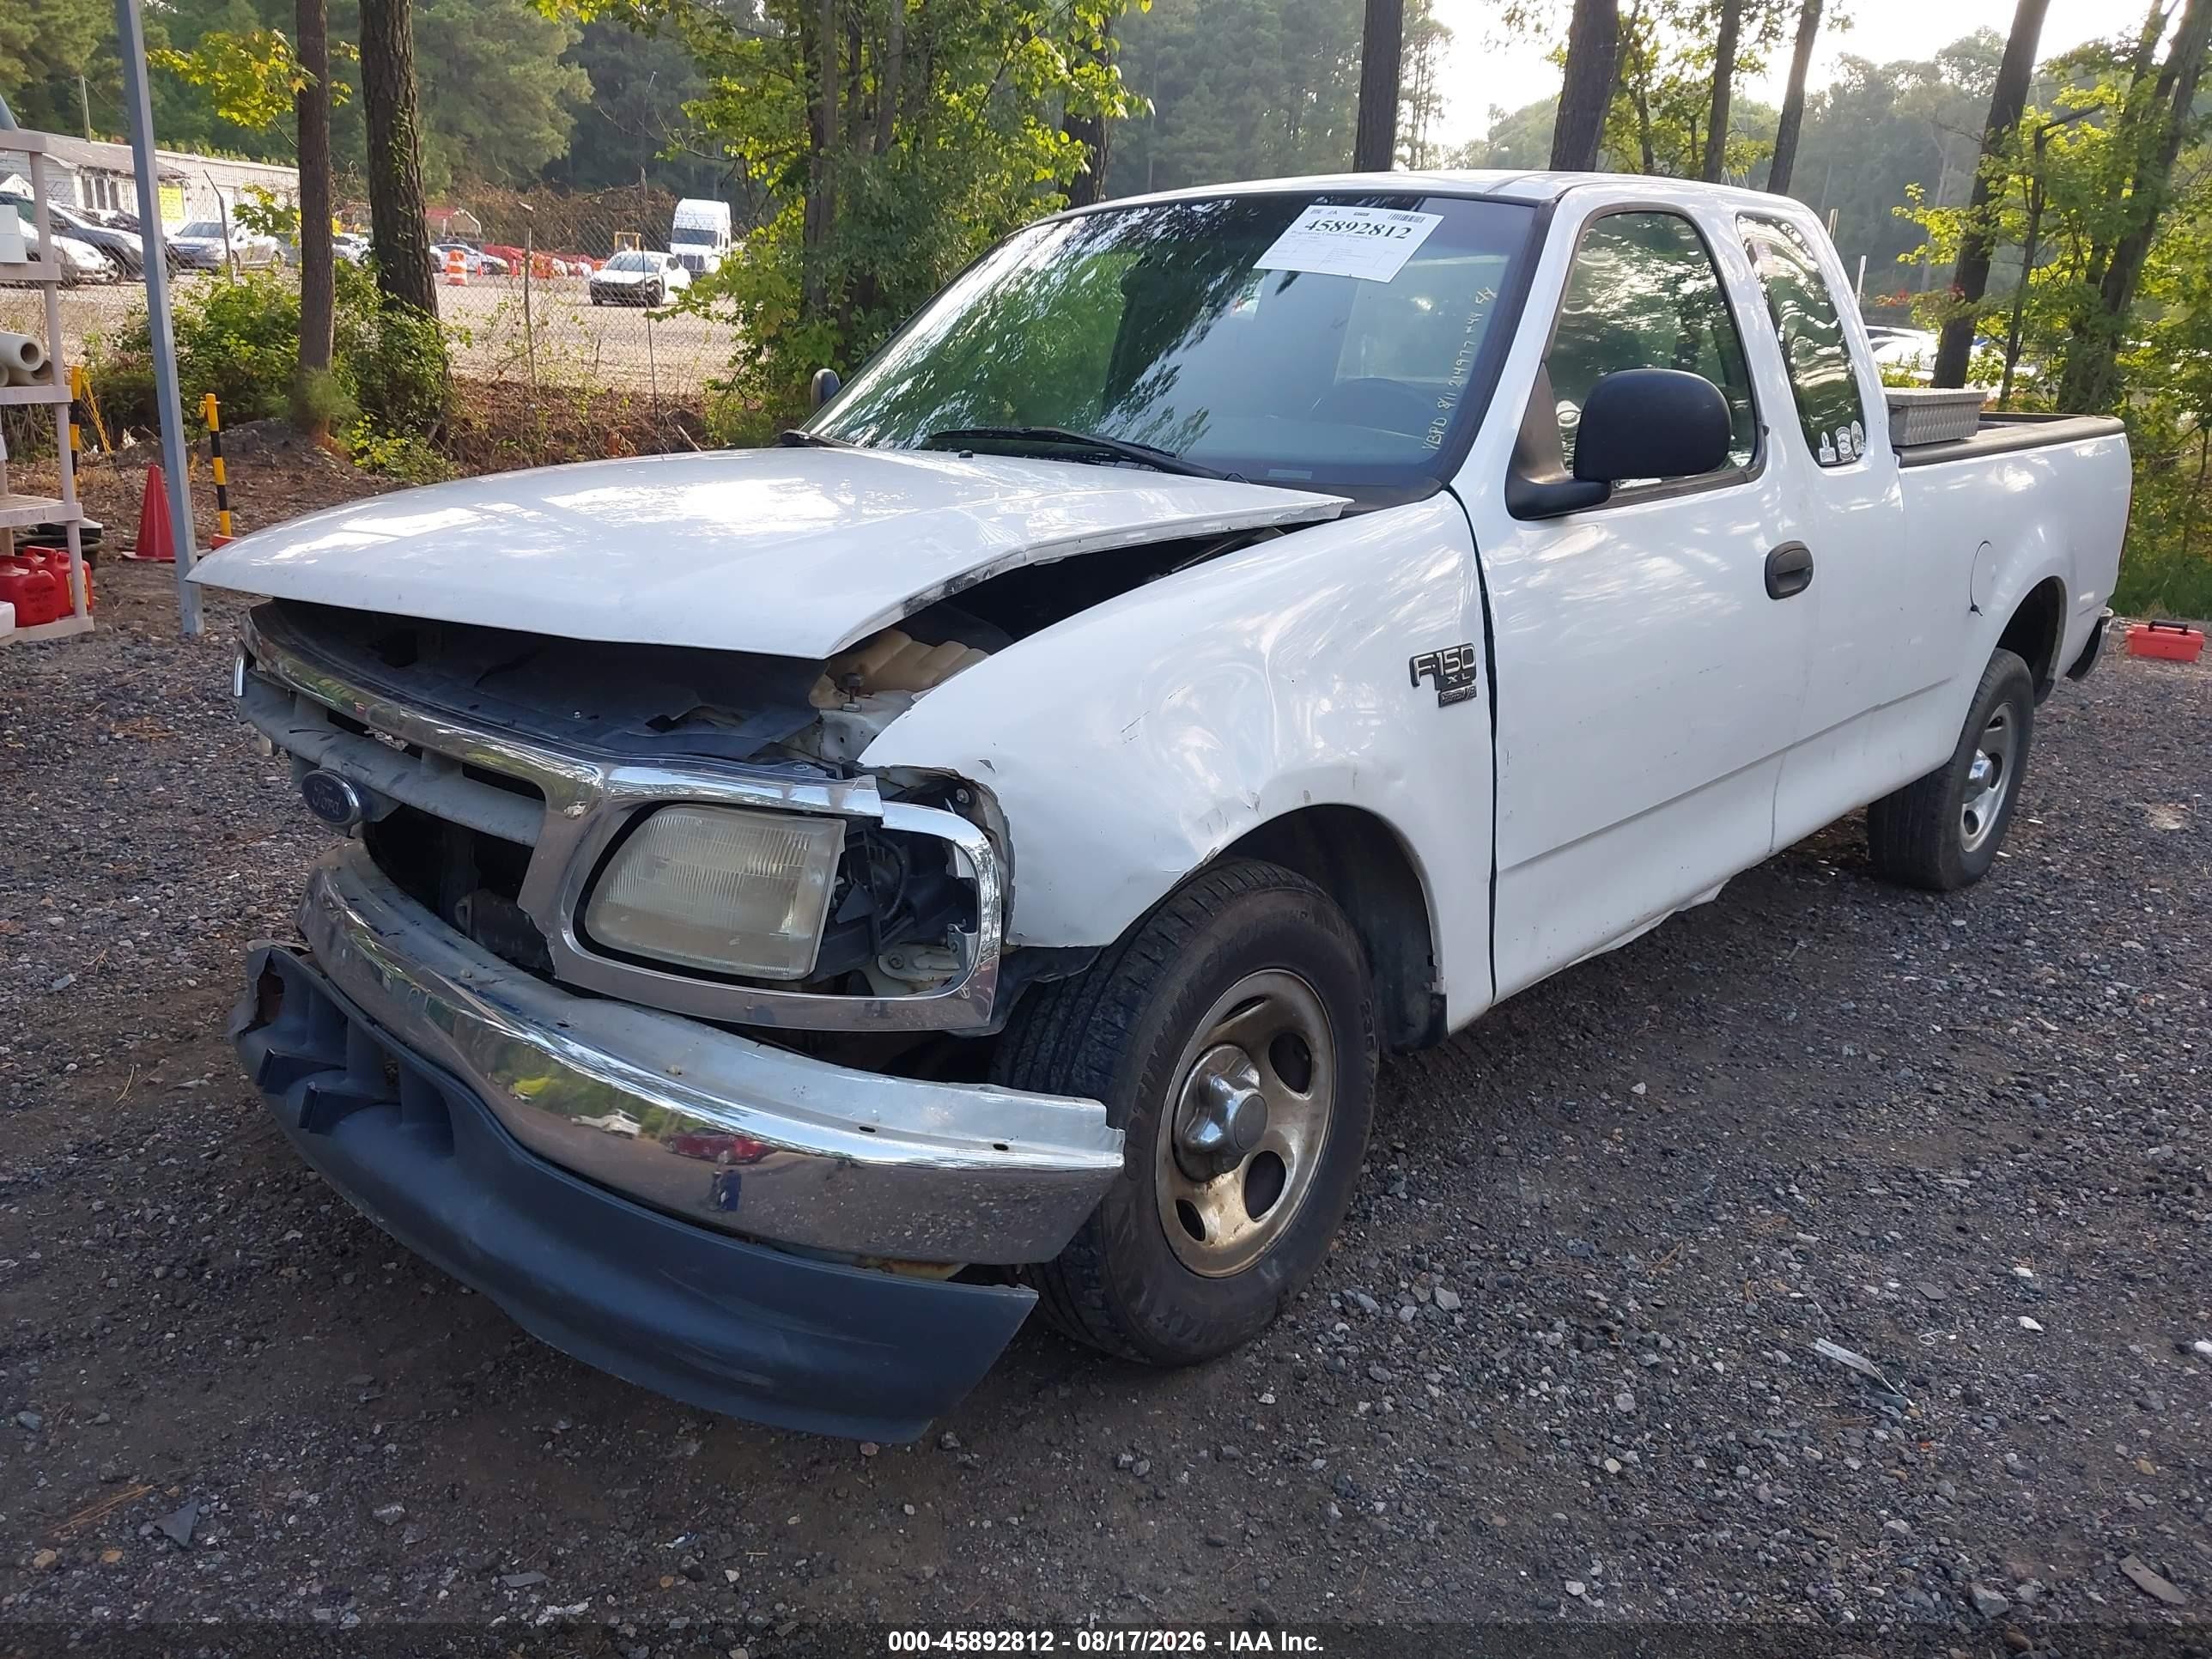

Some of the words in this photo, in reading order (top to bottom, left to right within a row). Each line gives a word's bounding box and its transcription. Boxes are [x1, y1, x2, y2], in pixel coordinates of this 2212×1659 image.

[1304, 218, 1413, 240] 45892812
[1446, 672, 1471, 685] XL
[312, 781, 342, 815] Ford
